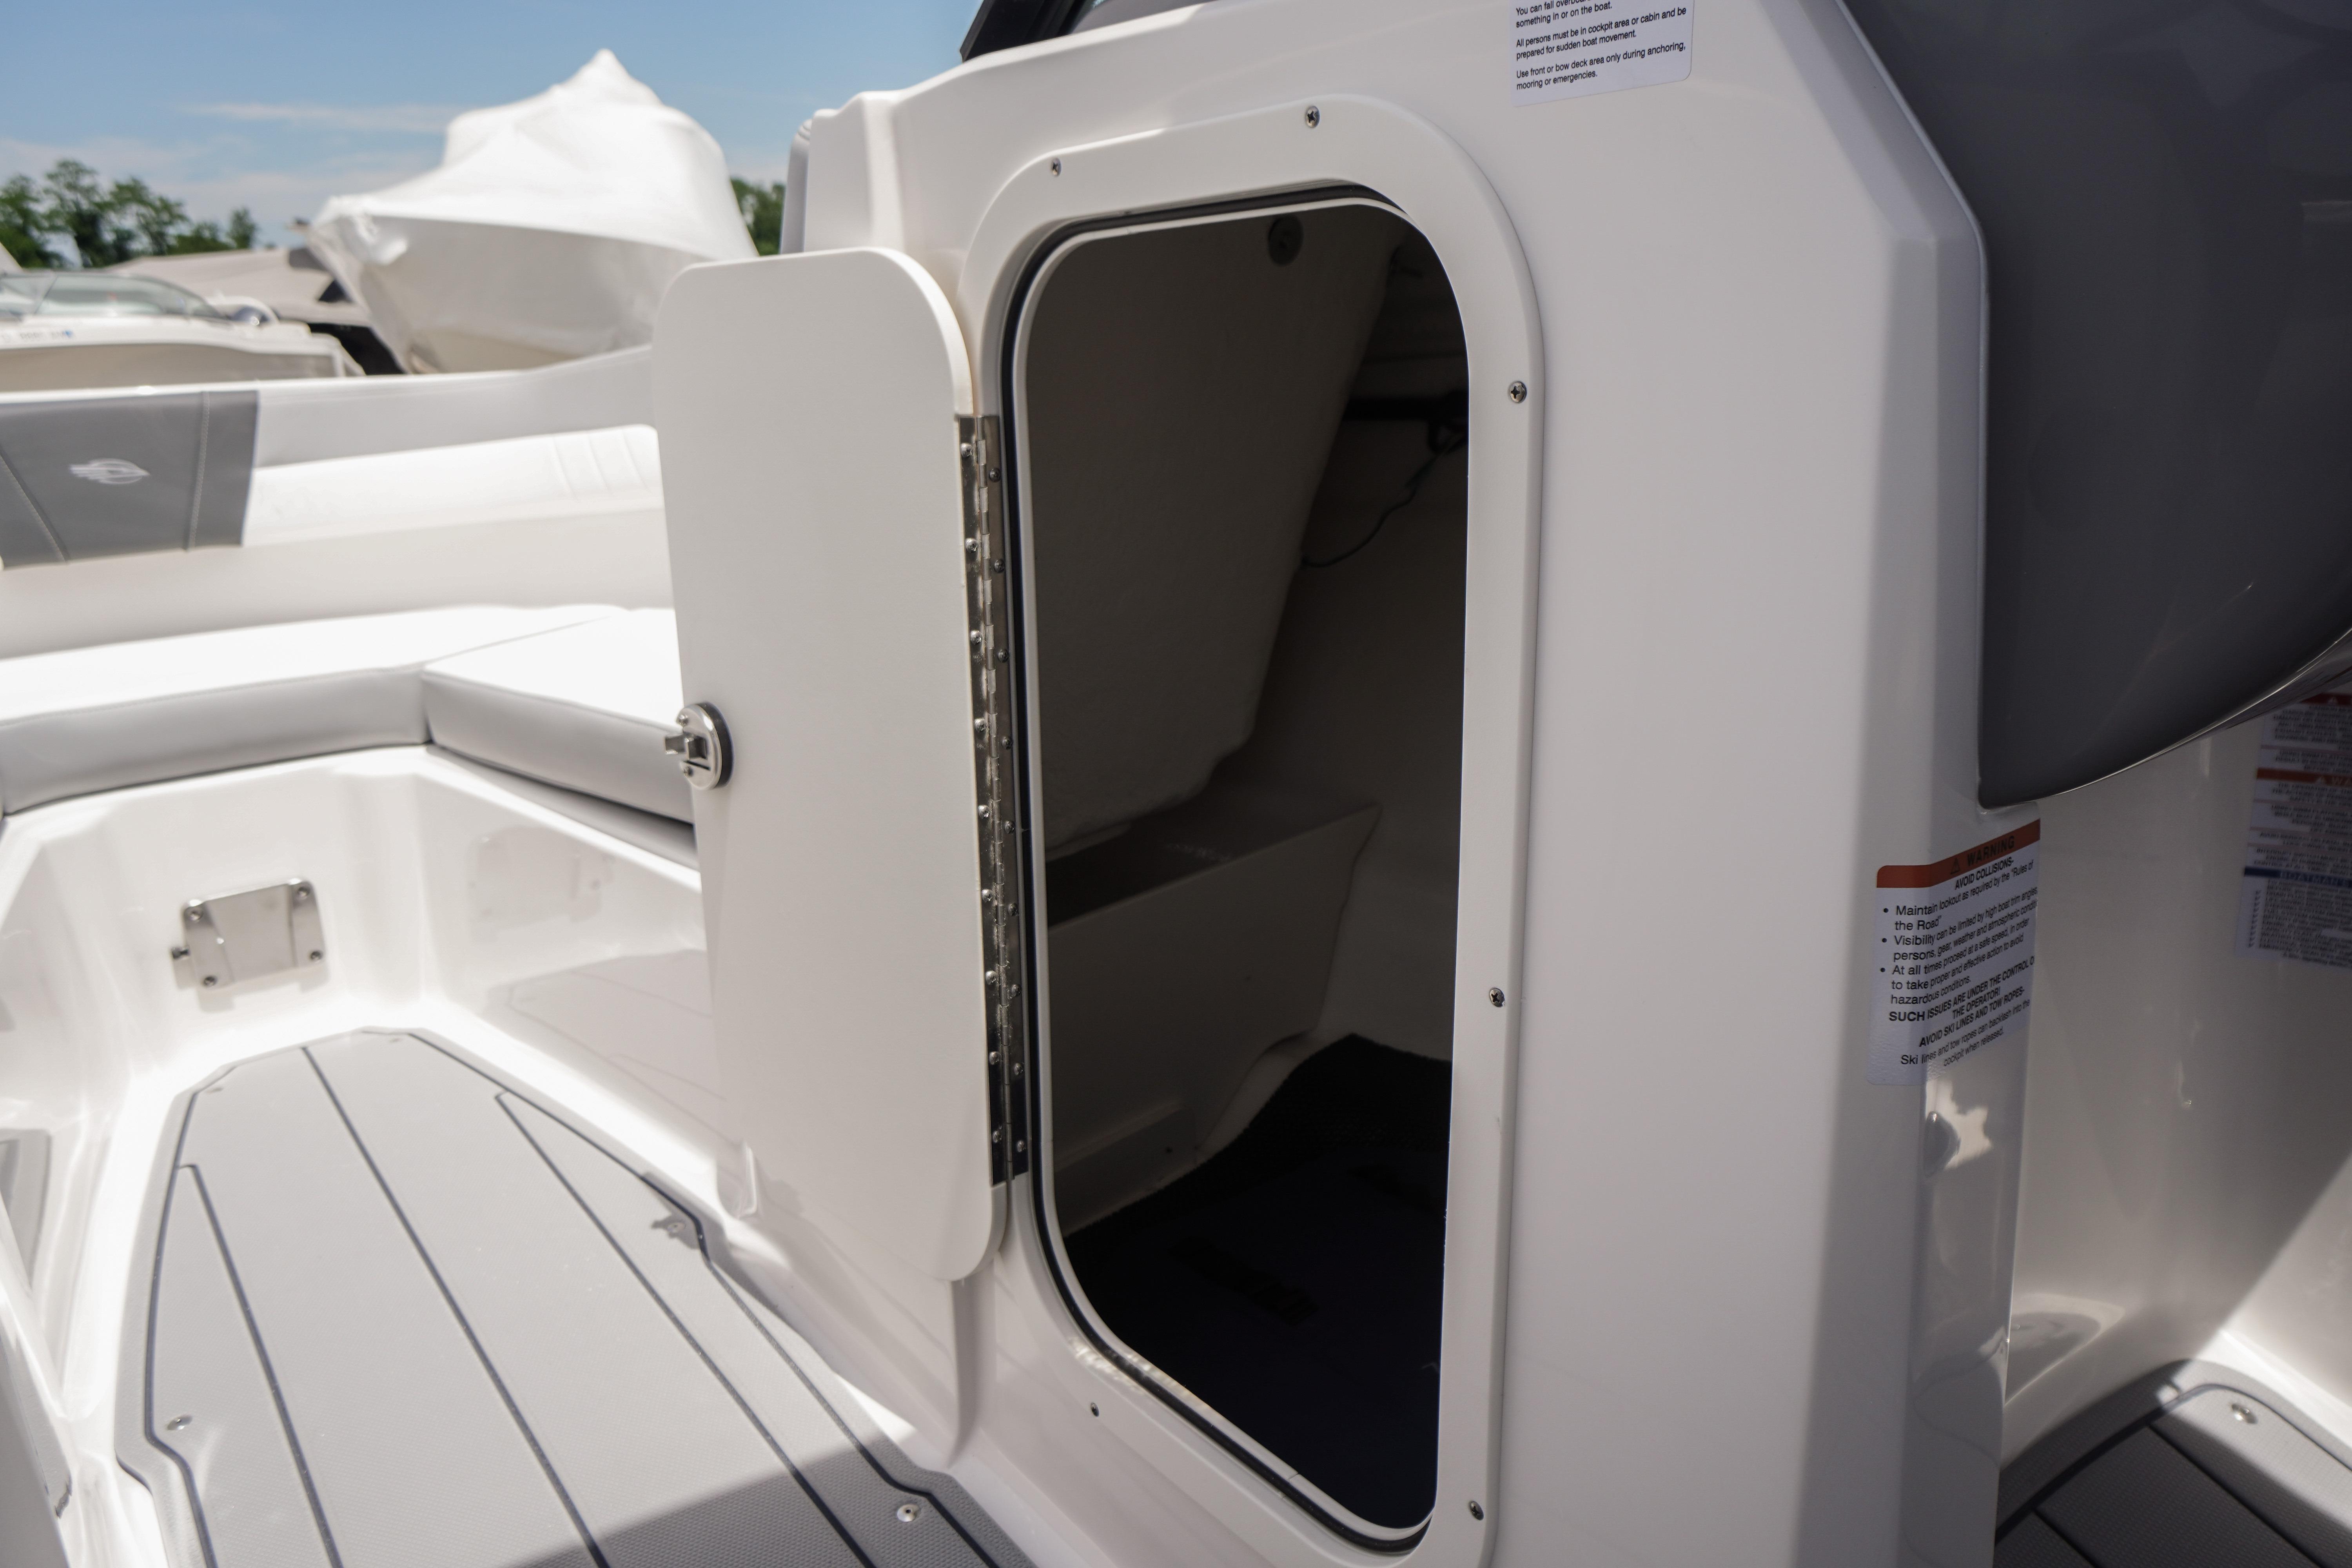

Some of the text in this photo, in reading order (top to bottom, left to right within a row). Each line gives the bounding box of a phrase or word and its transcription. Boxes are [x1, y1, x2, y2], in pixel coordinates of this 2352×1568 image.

[1516, 7, 1528, 16] You
[1544, 1, 1554, 11] fall
[1516, 15, 1551, 28] something
[1553, 12, 1559, 20] in
[1581, 5, 1592, 15] the
[1594, 2, 1612, 12] boat.
[1526, 34, 1551, 48] persons
[1553, 30, 1569, 39] must
[1570, 29, 1579, 37] be
[1581, 27, 1586, 35] in
[1588, 21, 1613, 33] cockpit
[1614, 19, 1630, 29] area
[1632, 17, 1639, 25] or
[1641, 12, 1660, 24] cabin
[1662, 7, 1675, 19] and
[1677, 7, 1686, 16] be
[1517, 29, 1636, 61] prepared for sudden boat movement.
[1517, 70, 1529, 78] Use
[1530, 66, 1545, 76] front
[1555, 63, 1570, 72] bow
[1571, 58, 1588, 69] deck
[1589, 56, 1604, 65] area
[1606, 53, 1621, 63] only
[1623, 49, 1646, 60] during
[1648, 42, 1686, 55] anchoring,
[1517, 80, 1543, 90] mooring
[1553, 70, 1597, 84] emergencies.
[1967, 836, 2014, 866] WARNING
[1896, 903, 1938, 915] Maintain
[1940, 893, 1961, 910] lookout
[1962, 891, 1969, 900] as
[1971, 878, 1993, 897] required
[1994, 877, 2000, 887] by
[2002, 872, 2010, 882] the
[2029, 859, 2034, 870] of
[1955, 873, 1975, 890] AVOID
[1894, 935, 1935, 946] Visibility
[1937, 929, 1947, 940] can
[1949, 926, 1956, 935] be
[1958, 914, 1976, 931] limited
[1978, 913, 1984, 923] by
[1986, 905, 1997, 918] high
[1998, 900, 2010, 912] boat
[2011, 895, 2020, 906] trim
[1894, 950, 1936, 962] persons,
[1938, 942, 1952, 956] gear,
[1954, 931, 1976, 947] weather
[1977, 923, 1987, 936] and
[1988, 909, 2020, 931] atmospheric
[1895, 920, 1913, 930] the
[1892, 965, 1905, 975] At
[1908, 965, 1921, 975] all
[1924, 960, 1942, 974] times
[1944, 947, 1967, 969] proceed
[1968, 945, 1973, 955] at
[1975, 943, 1978, 952] a
[1980, 936, 1991, 949] safe
[2010, 925, 2015, 933] in
[2016, 918, 2029, 931] order
[1892, 933, 2024, 989] to take proper and effective action to avoid
[1889, 1011, 1925, 1021] SUCH
[1928, 1000, 1952, 1019] ISSUES
[1953, 992, 1966, 1007] ARE
[1967, 981, 1988, 999] UNDER
[1990, 974, 2001, 987] THE
[2002, 960, 2029, 980] CONTROL
[1891, 976, 1971, 1004] hazardous conditions.
[1919, 1030, 1942, 1047] AVOID
[1944, 1023, 1955, 1036] SKI
[1956, 1013, 1974, 1030] LINES
[1975, 1006, 1988, 1019] AND
[1989, 997, 2003, 1012] TOW
[1953, 1005, 1965, 1019] THE
[1901, 1054, 1918, 1064] Ski
[1922, 1051, 1936, 1063] lines
[1938, 1042, 1949, 1056] and
[1951, 1039, 1960, 1049] tow
[1962, 1030, 1977, 1044] ropes
[1978, 1024, 1988, 1034] can
[2013, 1004, 2022, 1014] into
[1944, 1049, 1964, 1066] cockpit
[1965, 1041, 1979, 1055] when
